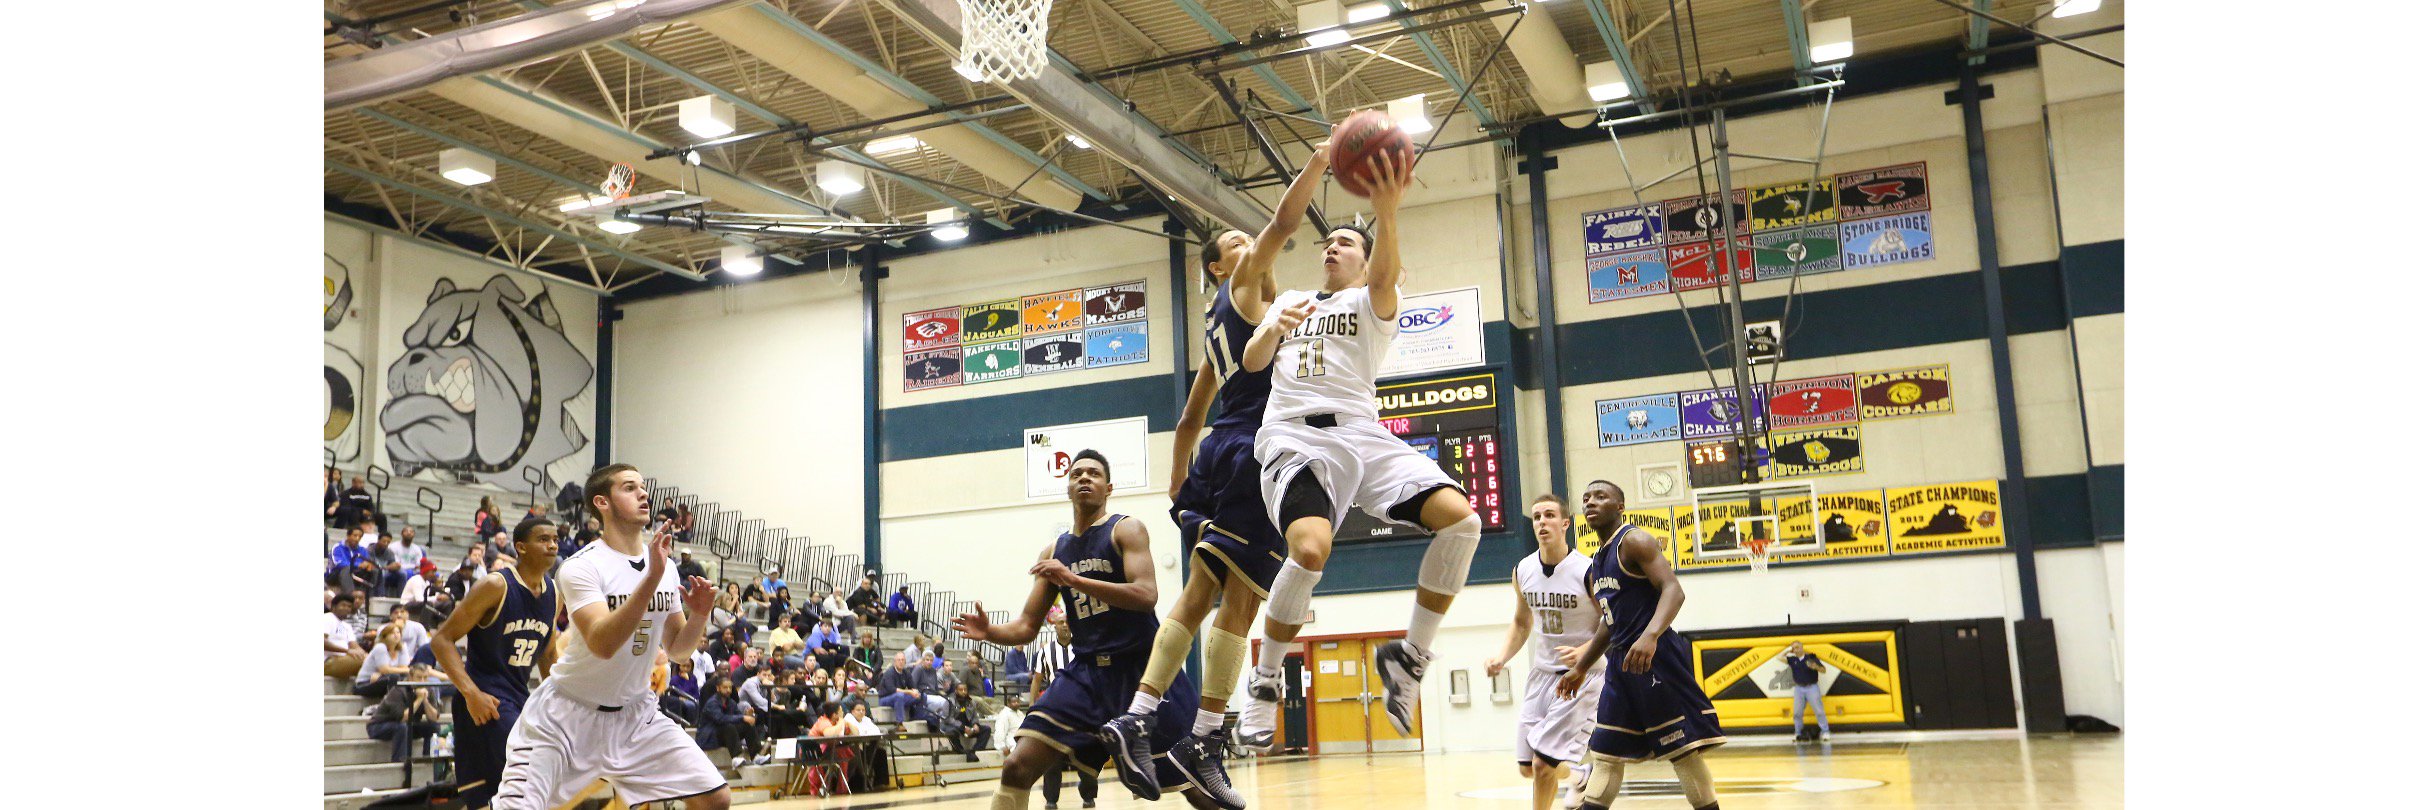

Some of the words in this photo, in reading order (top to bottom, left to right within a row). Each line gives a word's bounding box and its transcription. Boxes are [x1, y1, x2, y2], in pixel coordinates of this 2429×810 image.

[1586, 206, 1660, 228] FAIRFAX
[1845, 222, 1881, 243] STONE
[1885, 215, 1928, 232] BRIDGE
[1587, 234, 1663, 254] REBELS
[1671, 240, 1748, 261] McLEN
[1847, 242, 1930, 267] BULLDOGS
[1674, 267, 1751, 288] HIGHLANDRS
[1592, 280, 1667, 299] STATESMEN
[1024, 317, 1081, 333] HAWKS
[1086, 307, 1145, 324] MAJORS
[1398, 312, 1437, 328] OBC
[963, 324, 1019, 341] JAGUARS
[1284, 313, 1358, 342] LLDOGS
[964, 341, 1019, 357] WAKEFIELD
[1088, 351, 1146, 365] PATRIOTS
[1206, 321, 1239, 390] 11
[1297, 339, 1326, 378] 11
[964, 365, 1020, 382] WARRIORS
[1860, 368, 1946, 389] OAKTON
[1599, 397, 1677, 415] CENTREVILLE
[1683, 388, 1762, 406] CHANTIY
[1772, 407, 1855, 426] HORNETS
[1863, 397, 1950, 418] COUGARS
[1379, 418, 1409, 433] TOR
[1602, 426, 1678, 443] WILDCATS
[1685, 416, 1763, 435] CHARGES
[1774, 428, 1858, 446] WESTFIELD
[1454, 445, 1462, 458] 3
[1466, 444, 1474, 457] 2
[1486, 442, 1494, 455] 8
[1455, 463, 1463, 474] 4
[1471, 461, 1476, 473] 1
[1487, 459, 1496, 472] 6
[1777, 456, 1861, 476] BULLDOGS
[1472, 478, 1477, 490] 1
[1488, 476, 1497, 489] 6
[1470, 495, 1477, 508] 2
[1486, 493, 1498, 507] 12
[1780, 500, 1813, 521] STATE
[1817, 496, 1881, 514] CHAMPIONS
[1889, 491, 1924, 513] STATE
[1926, 487, 1998, 506] CHAMPIONS
[1491, 511, 1499, 524] 2
[1629, 513, 1670, 532] CHAMPIONS
[1676, 508, 1712, 530] WACHVIA
[1713, 504, 1728, 519] CUP
[1371, 527, 1392, 536] GAME
[1833, 545, 1885, 556] ACTIVITIES
[1896, 541, 1942, 550] ACADEMIC
[1946, 537, 2001, 547] ACTIVITIES
[1070, 558, 1113, 575] AGONS
[1594, 577, 1620, 595] AGONS
[607, 591, 674, 612] BUDOG
[503, 618, 550, 637] DRAGON
[632, 619, 652, 656] 5
[508, 638, 539, 667] 32
[1713, 653, 1760, 686] WESTFIELD
[1829, 651, 1879, 681] BULLDOGS
